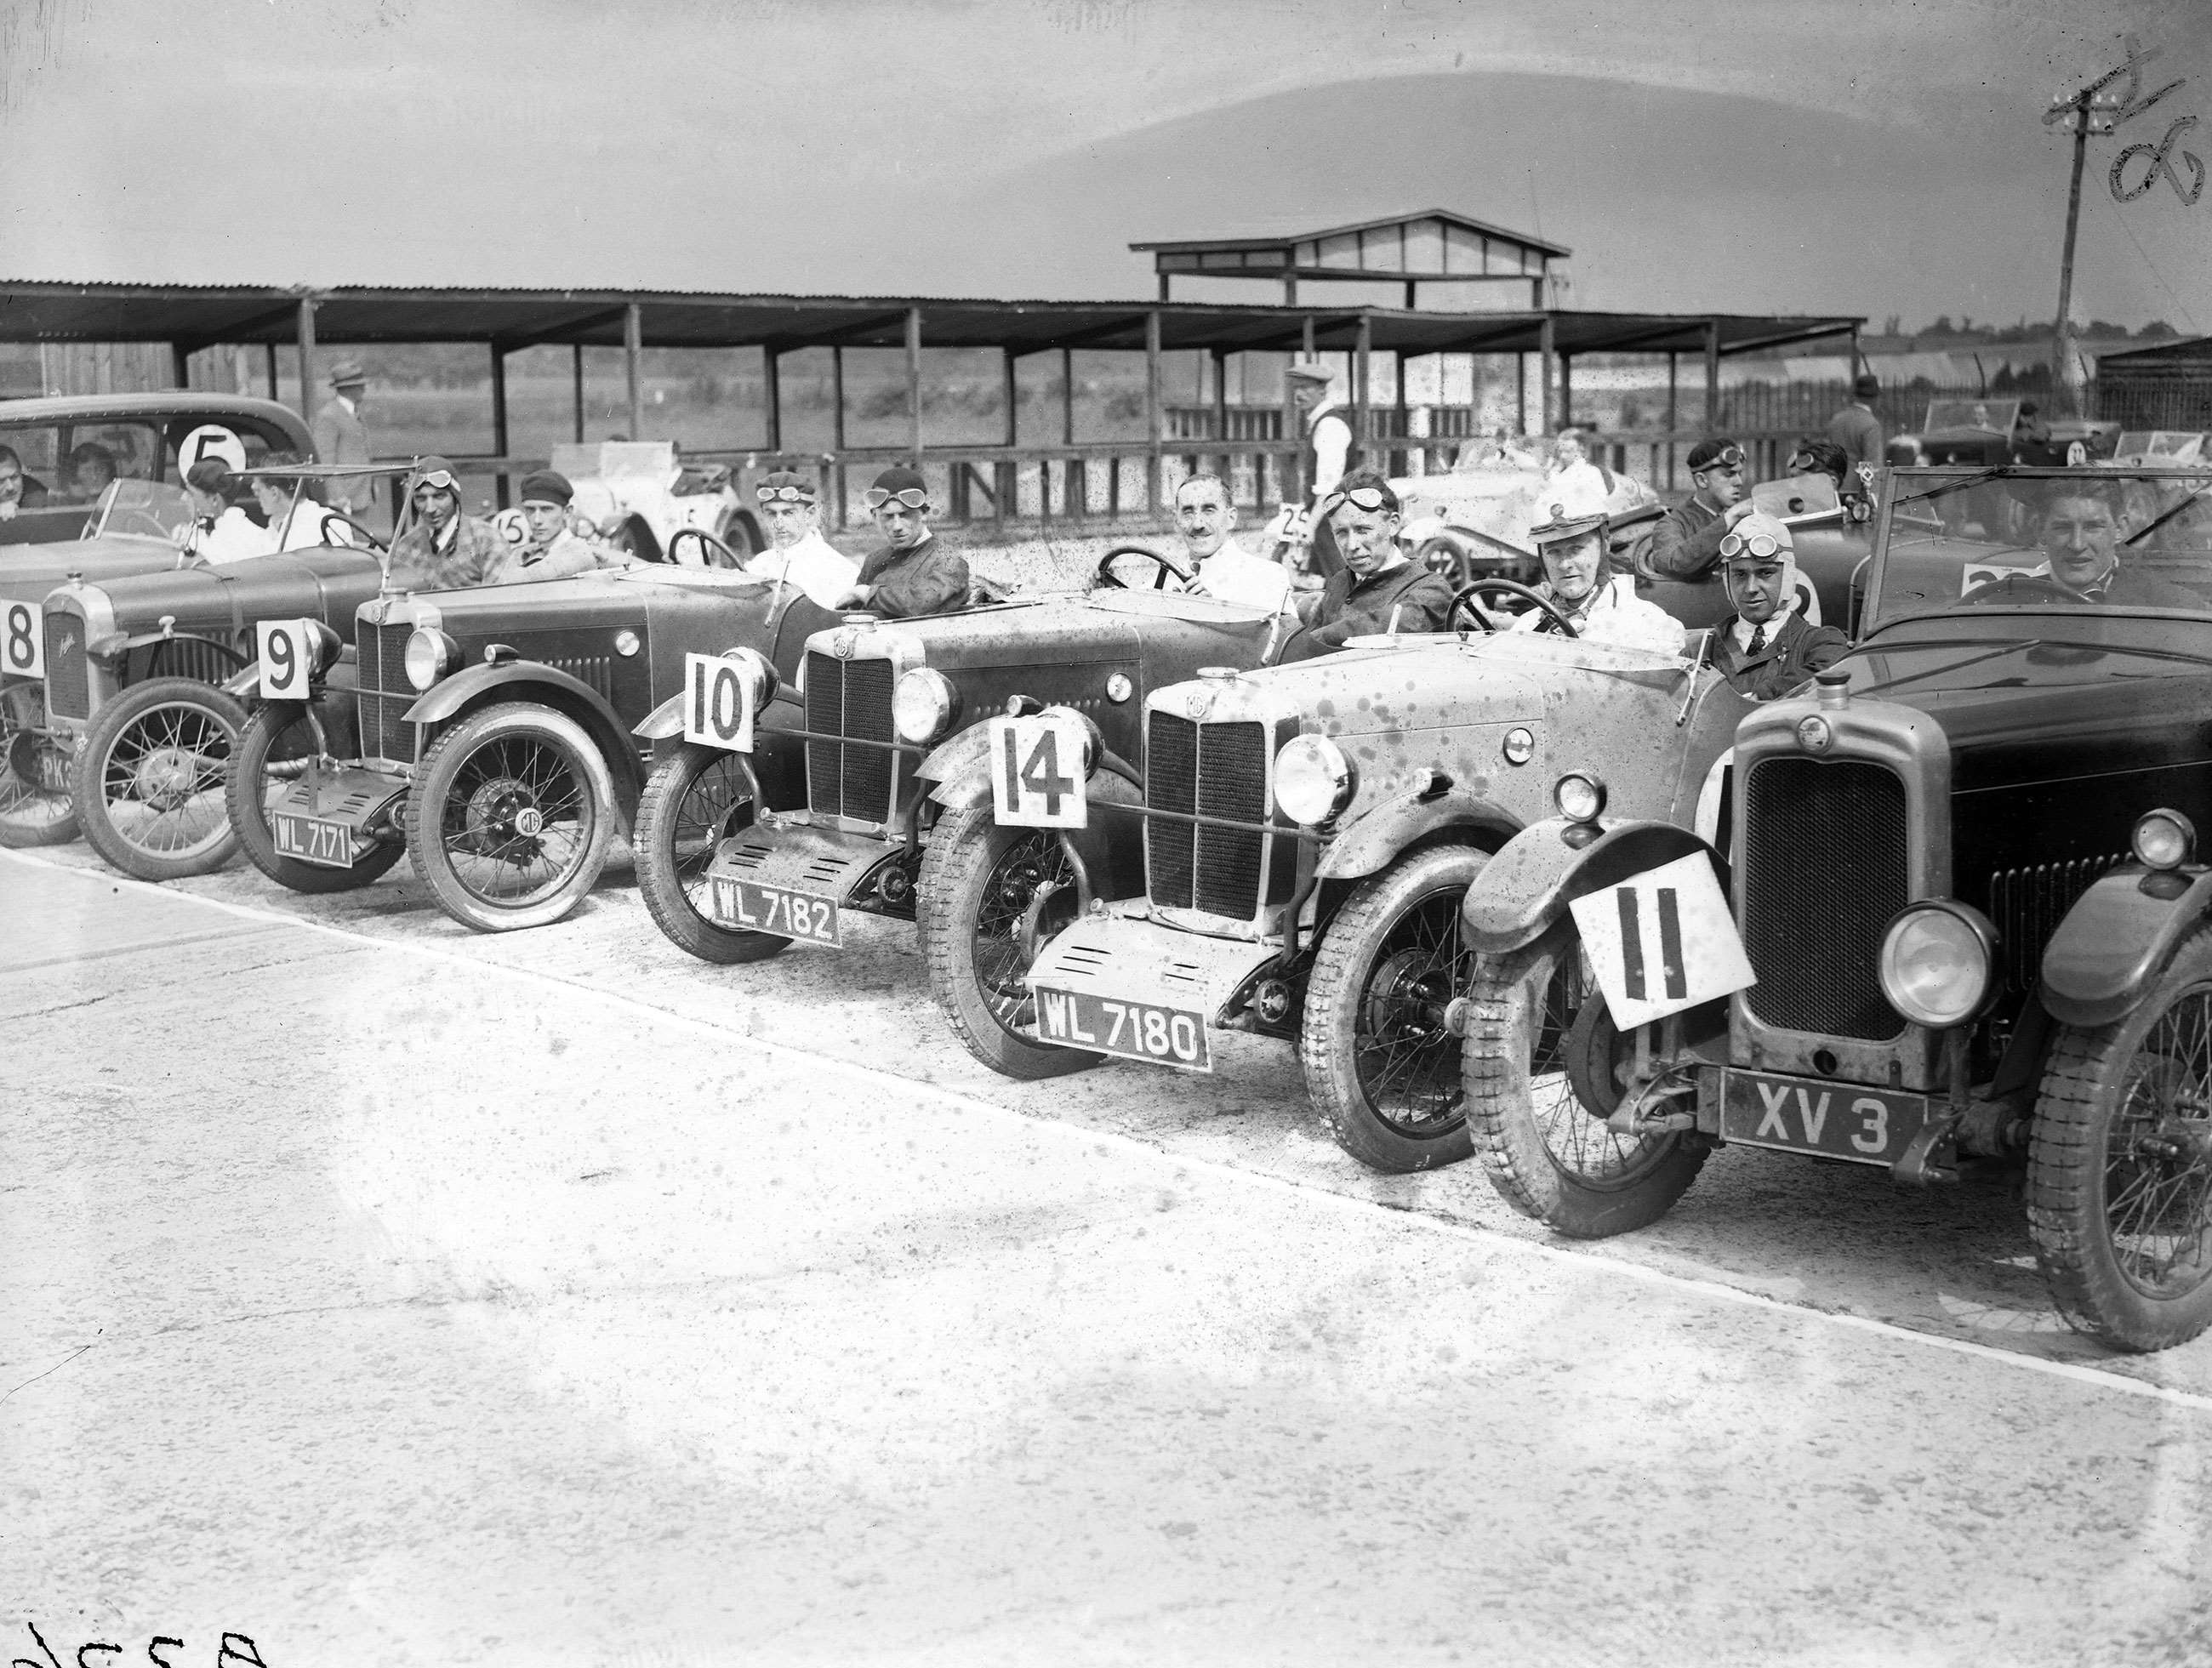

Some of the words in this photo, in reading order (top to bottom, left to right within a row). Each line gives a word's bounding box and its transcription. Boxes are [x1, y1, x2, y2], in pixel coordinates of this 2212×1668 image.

[9, 604, 35, 669] 8
[268, 629, 295, 690] 9
[694, 662, 743, 741] 10
[1004, 728, 1074, 816] 14
[277, 817, 305, 852] WL
[307, 822, 346, 861] 7171
[522, 811, 540, 833] MG
[717, 881, 756, 925] WL
[761, 891, 833, 939] 7182
[1616, 886, 1687, 1000] 11
[1043, 992, 1096, 1044] WL
[1103, 1002, 1198, 1061] 7180
[1756, 1082, 1831, 1144] XV
[1850, 1098, 1889, 1153] 3
